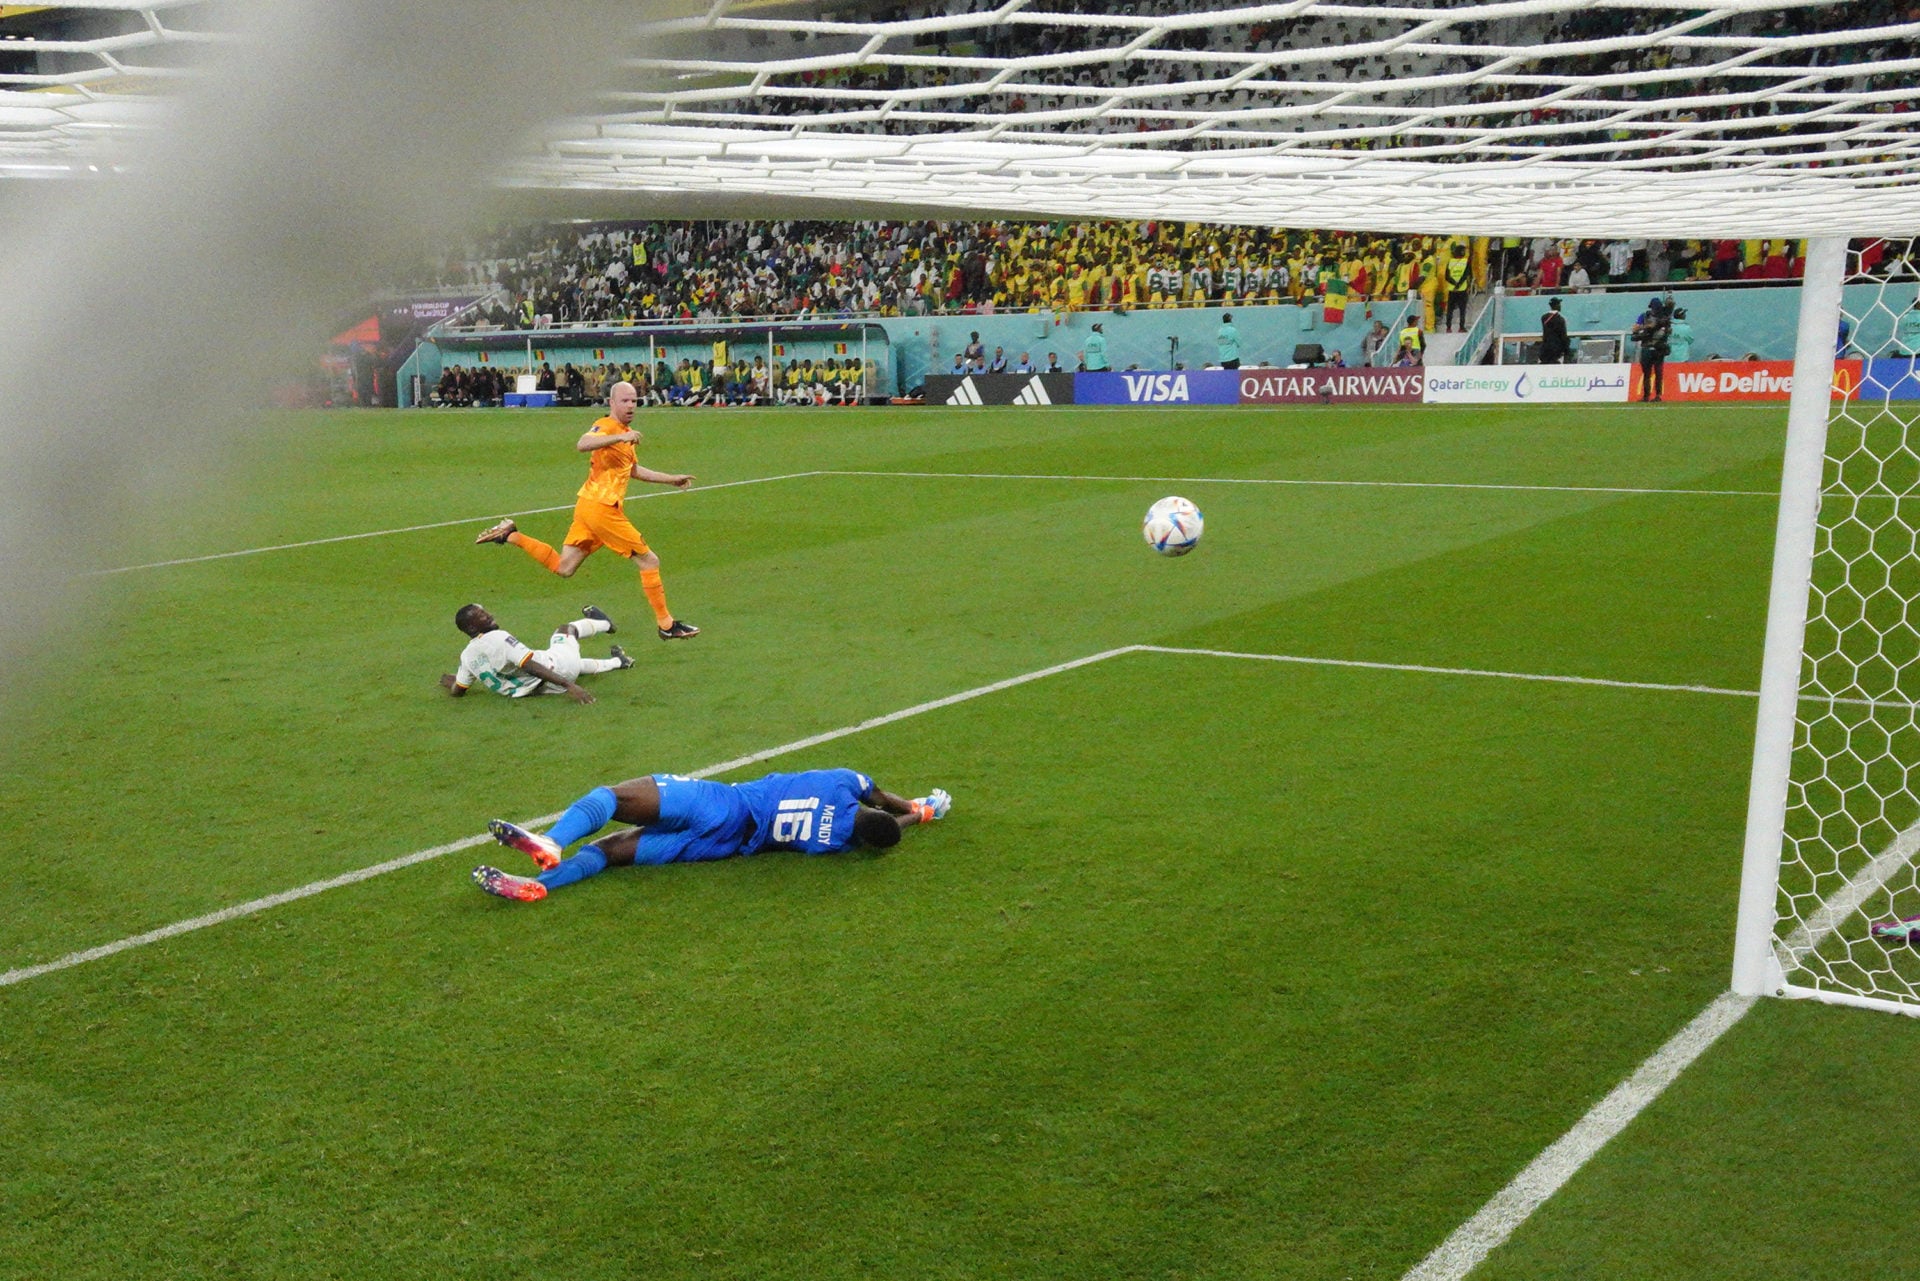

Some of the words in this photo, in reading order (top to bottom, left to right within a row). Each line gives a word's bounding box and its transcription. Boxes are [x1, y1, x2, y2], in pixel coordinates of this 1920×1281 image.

[1121, 374, 1190, 401] VISA
[1241, 377, 1316, 398] QATAR
[1323, 375, 1422, 396] AIRWAYS
[1429, 378, 1510, 392] QatarEnergy
[1678, 373, 1715, 393] We
[1720, 370, 1793, 393] Delive
[772, 797, 819, 843] 16
[817, 804, 836, 846] MENDY
